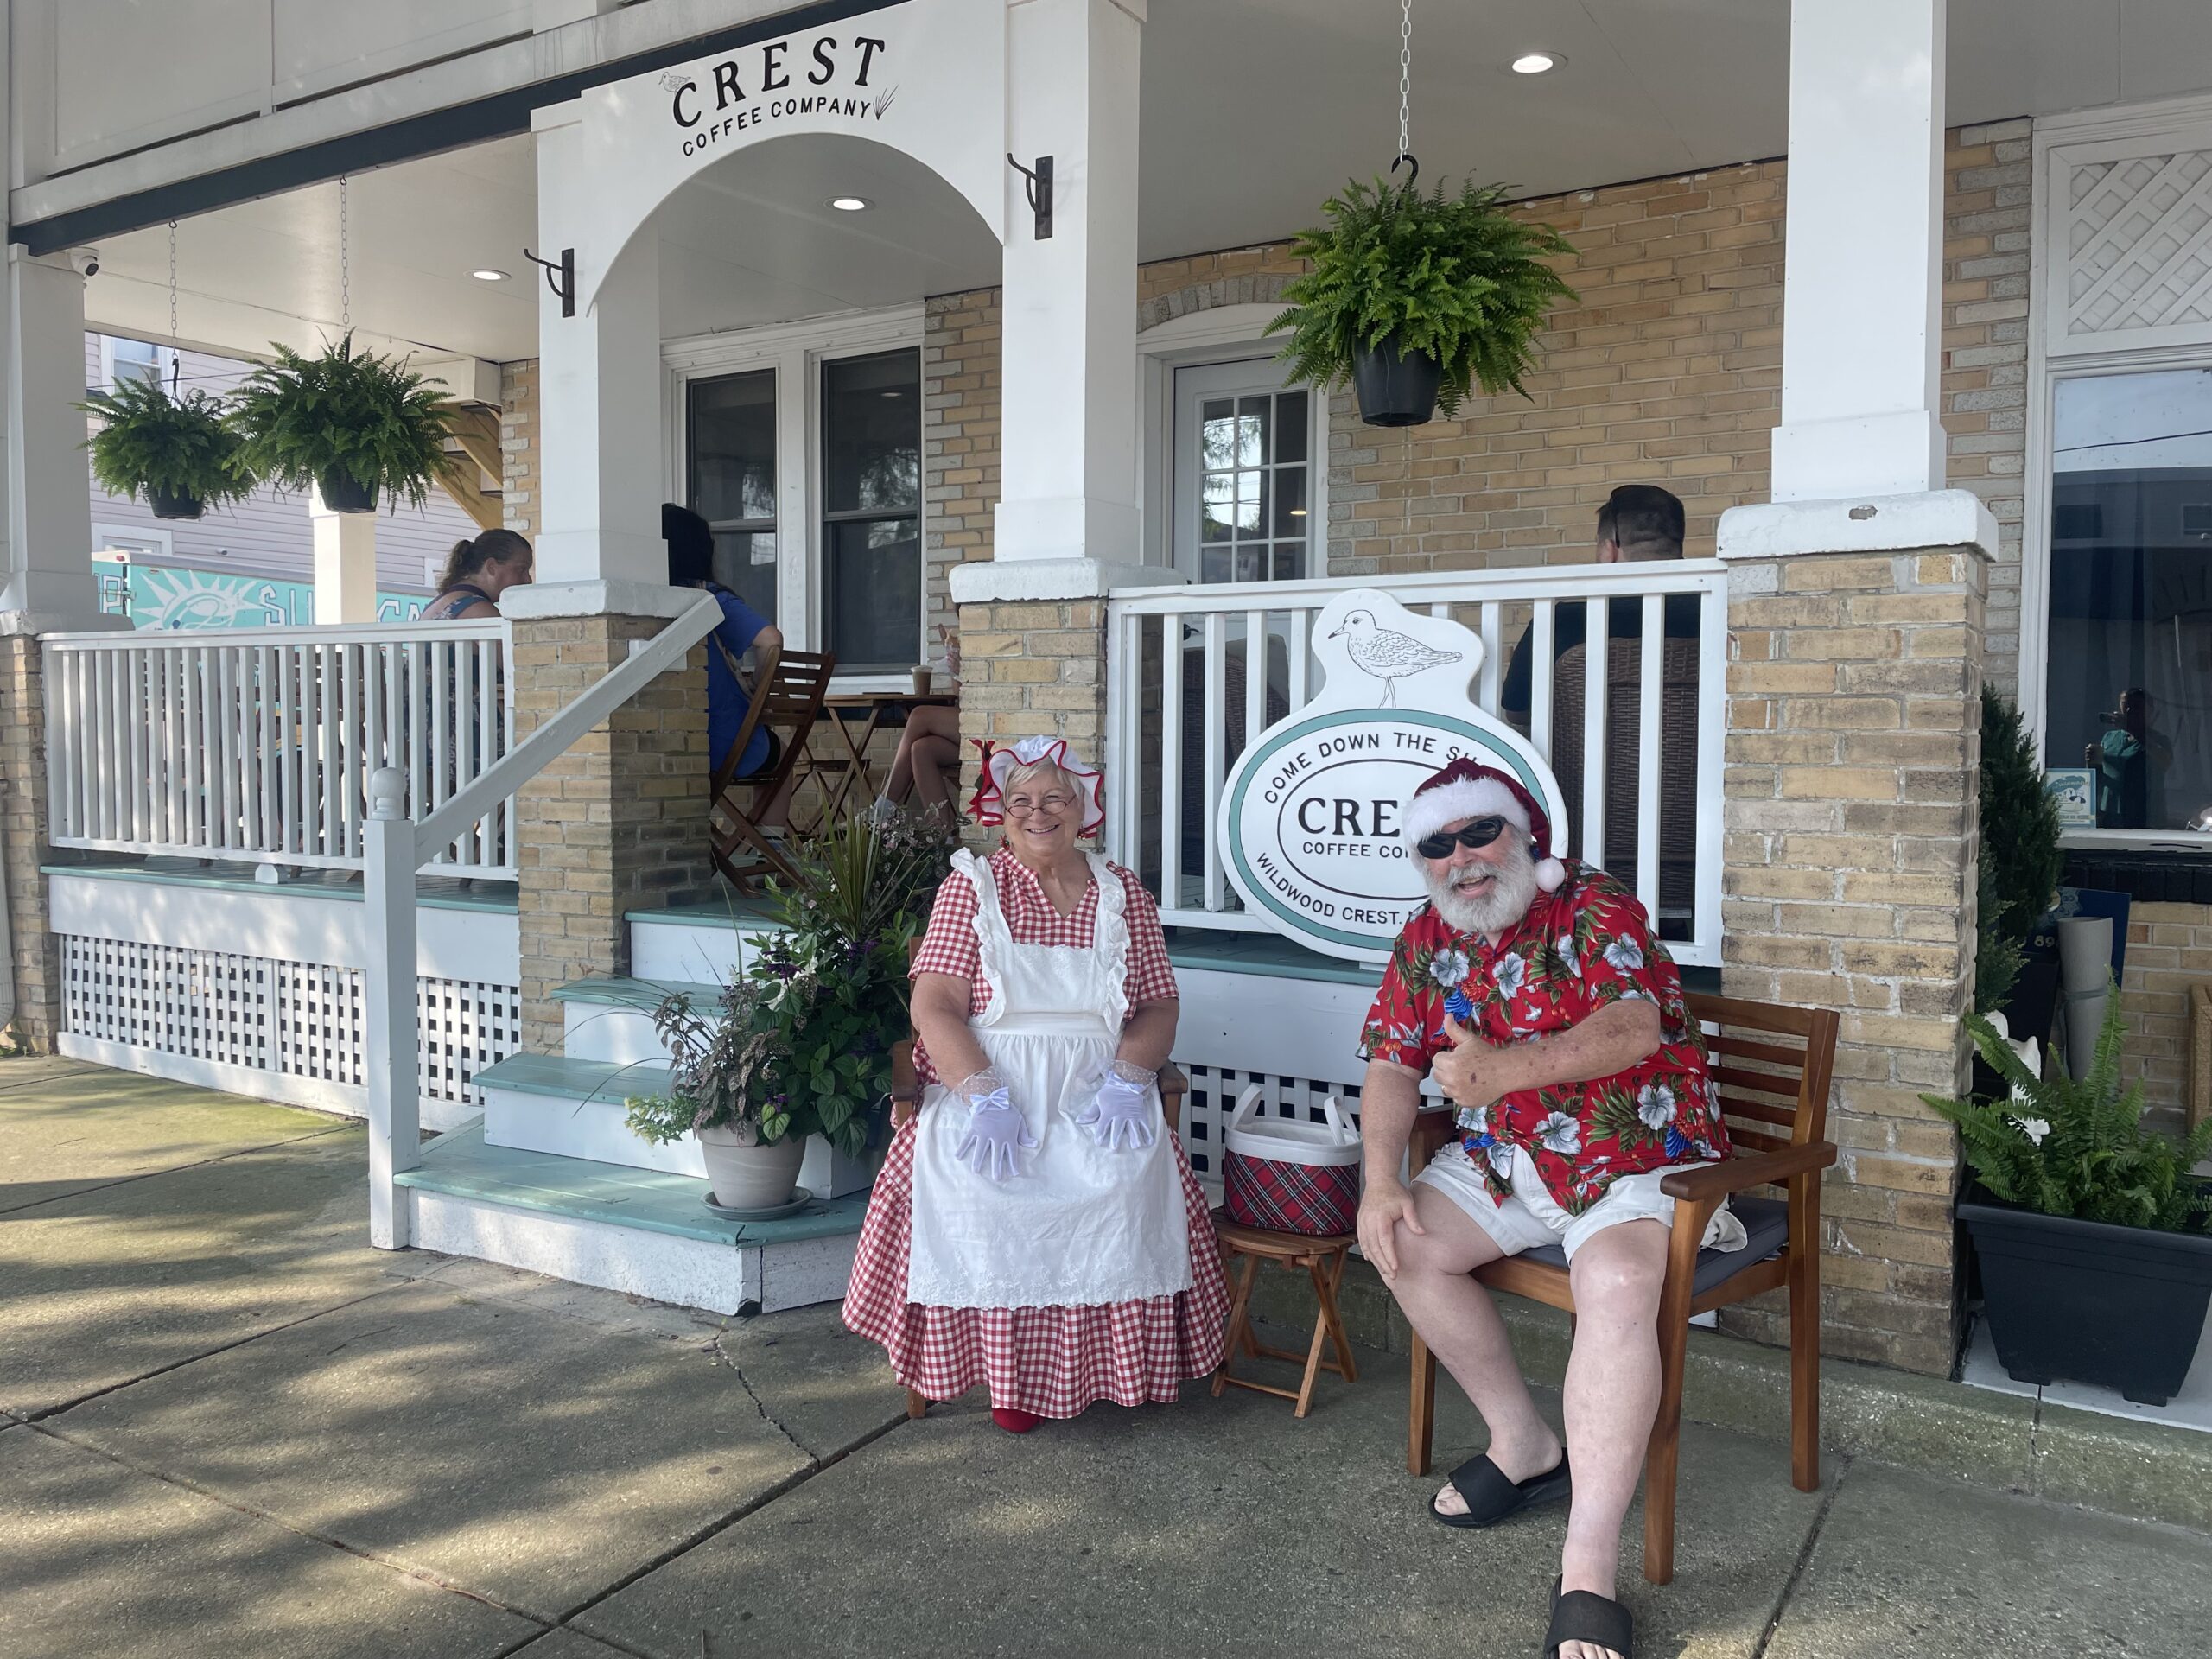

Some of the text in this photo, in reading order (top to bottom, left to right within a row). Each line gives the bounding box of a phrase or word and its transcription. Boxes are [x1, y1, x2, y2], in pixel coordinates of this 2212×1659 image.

[672, 36, 886, 128] CREST
[683, 96, 872, 157] COFFEE COMPANY
[1264, 752, 1312, 804] COME
[1318, 733, 1380, 758] DOWN
[1393, 732, 1437, 753] THE
[1298, 797, 1400, 837] CRE
[1302, 841, 1371, 858] COFFEE
[1256, 852, 1335, 918] WILDWOOD
